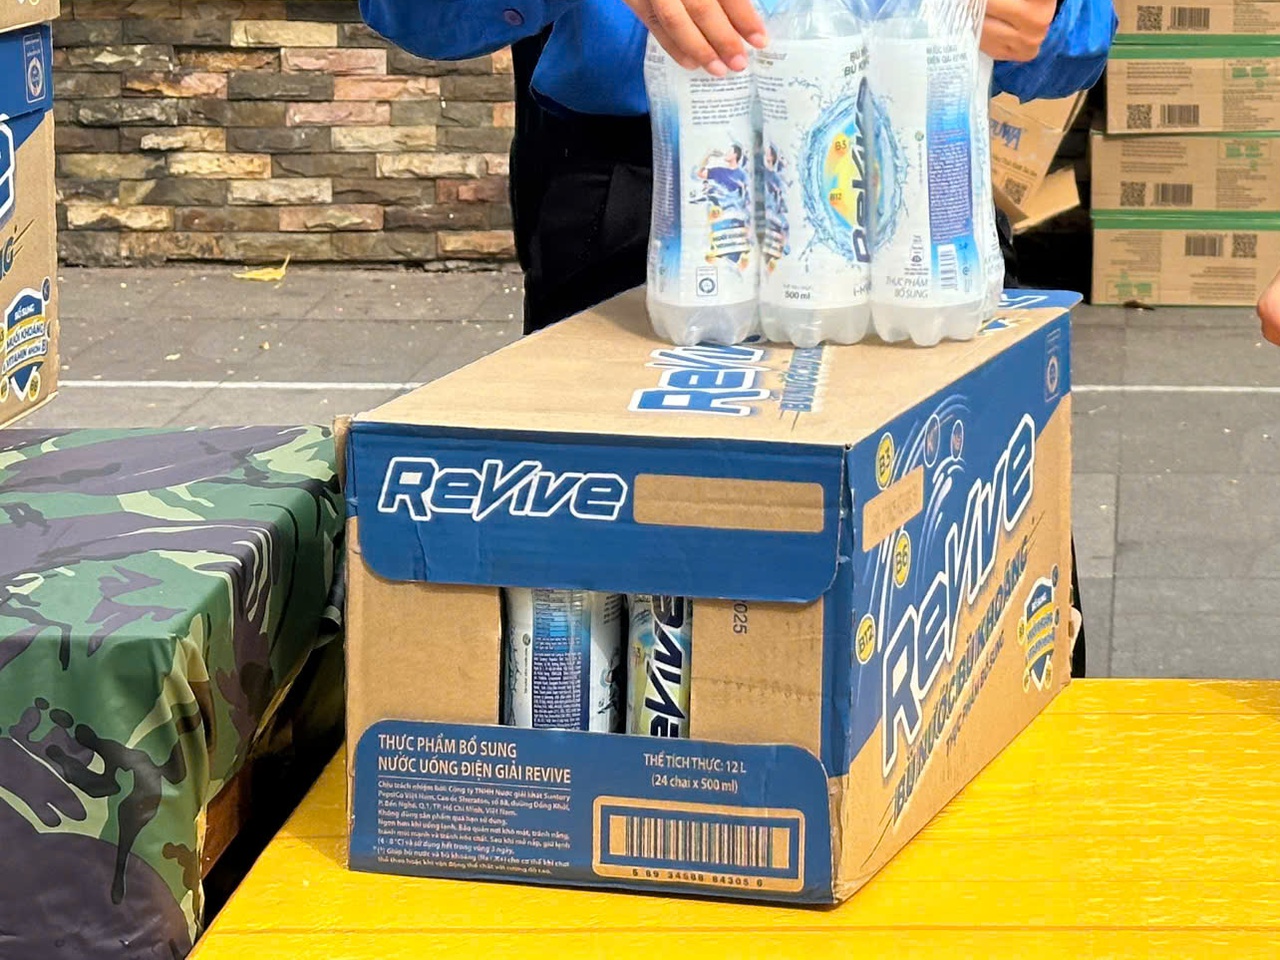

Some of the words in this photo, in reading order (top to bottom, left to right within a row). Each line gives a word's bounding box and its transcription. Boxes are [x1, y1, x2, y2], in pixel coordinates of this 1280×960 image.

[835, 140, 847, 150] B3
[785, 291, 800, 299] 500
[801, 290, 811, 300] ml
[377, 456, 630, 522] ReVive
[882, 413, 1036, 780] ReVive
[733, 600, 750, 636] 025
[643, 595, 687, 738] eVive
[378, 734, 414, 755] THỰC
[417, 735, 456, 754] PHẨM
[459, 735, 477, 756] BỔ
[480, 741, 517, 758] SUNG
[378, 754, 417, 773] NƯỚC
[419, 756, 458, 776] UỐNG
[461, 760, 492, 781] ĐIỆN
[495, 760, 522, 780] GIẢI
[525, 767, 572, 784] REVIVE
[643, 750, 664, 767] THỂ
[726, 760, 738, 773] 12
[740, 762, 747, 774] L
[652, 774, 668, 788] (24
[670, 775, 691, 788] chai
[692, 780, 699, 788] x
[701, 778, 720, 790] 500
[721, 778, 739, 794] ml)
